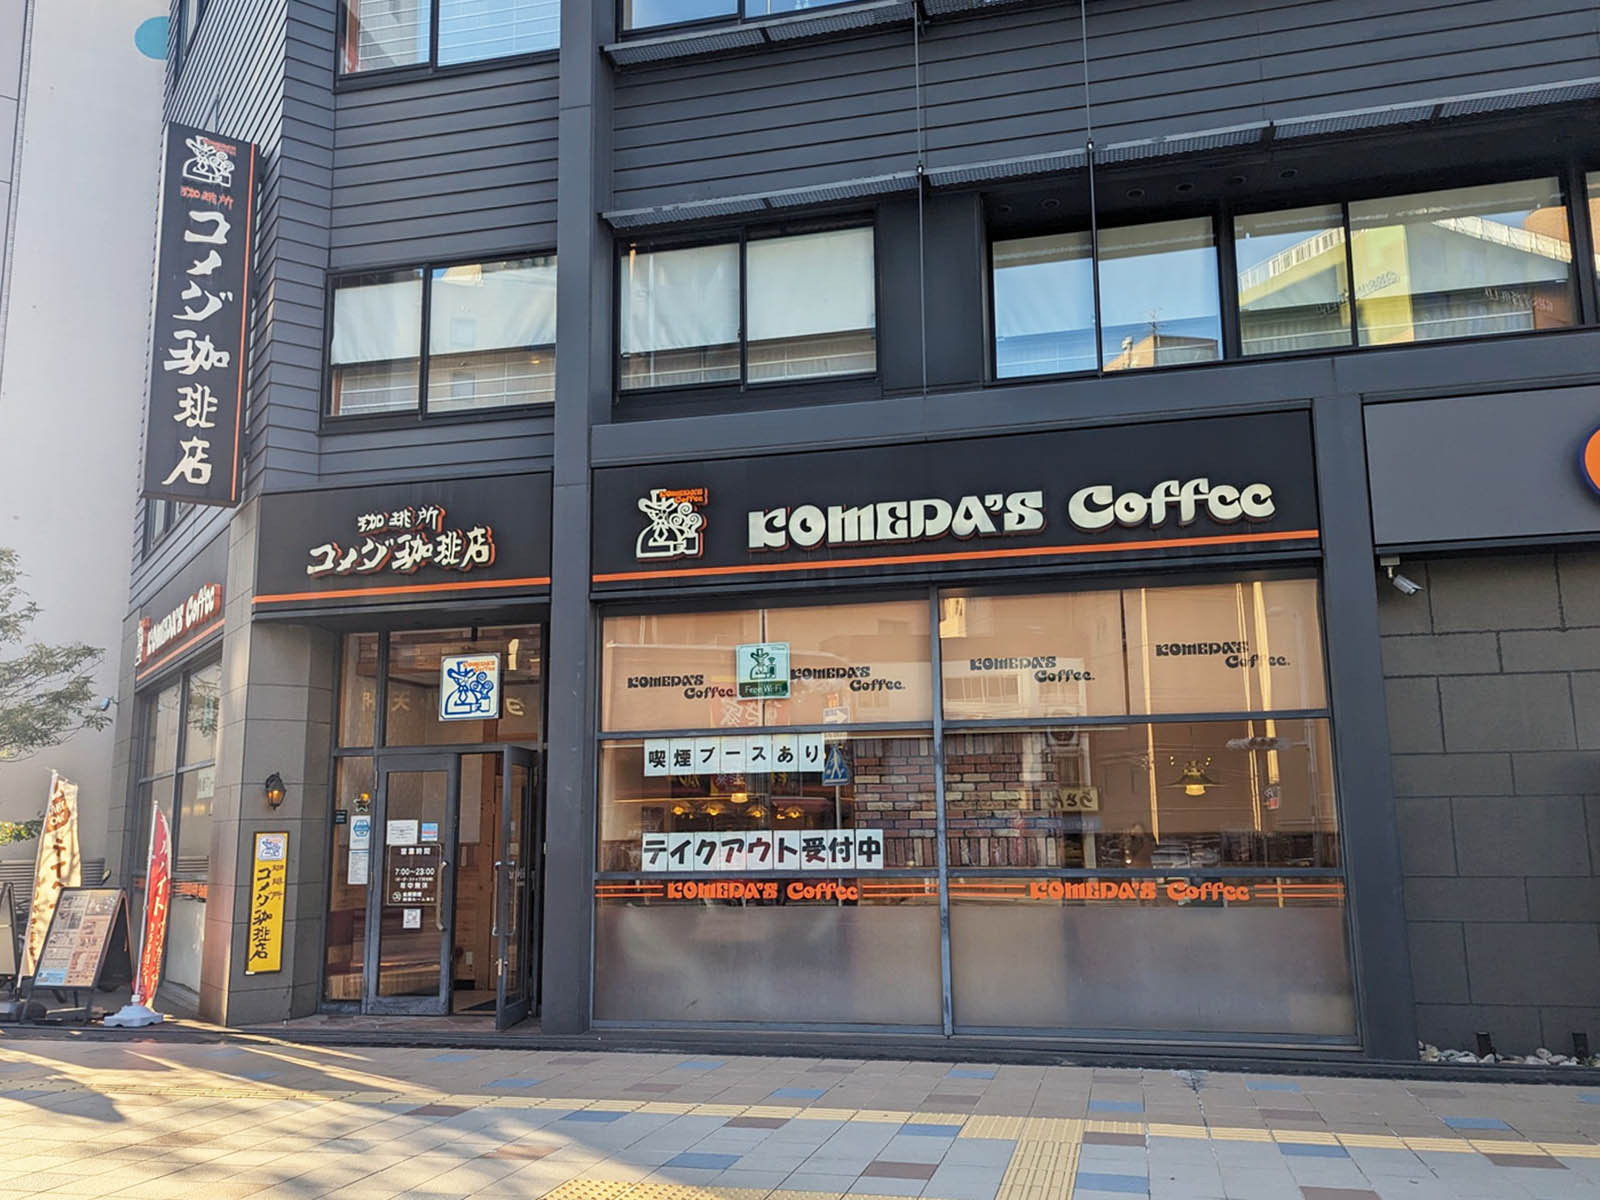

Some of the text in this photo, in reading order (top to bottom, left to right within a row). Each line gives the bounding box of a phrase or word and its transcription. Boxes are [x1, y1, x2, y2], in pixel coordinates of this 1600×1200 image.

[161, 210, 233, 485] コメダ珈琲店
[357, 505, 445, 533] 珈琲所
[748, 478, 1276, 550] KOMEDA'S Coffee
[306, 526, 494, 576] コメダ珈琲店
[1155, 641, 1250, 656] KOMEDA'S
[969, 656, 1057, 671] KOMEDA'S
[627, 674, 704, 688] KOMEDA'S
[648, 744, 820, 768] 喫煙ブースあり
[643, 835, 882, 864] テイクアウト受付中
[666, 882, 858, 901] KOMEDA'S Coffee
[1029, 882, 1249, 901] KOMEDA'S Coffee
